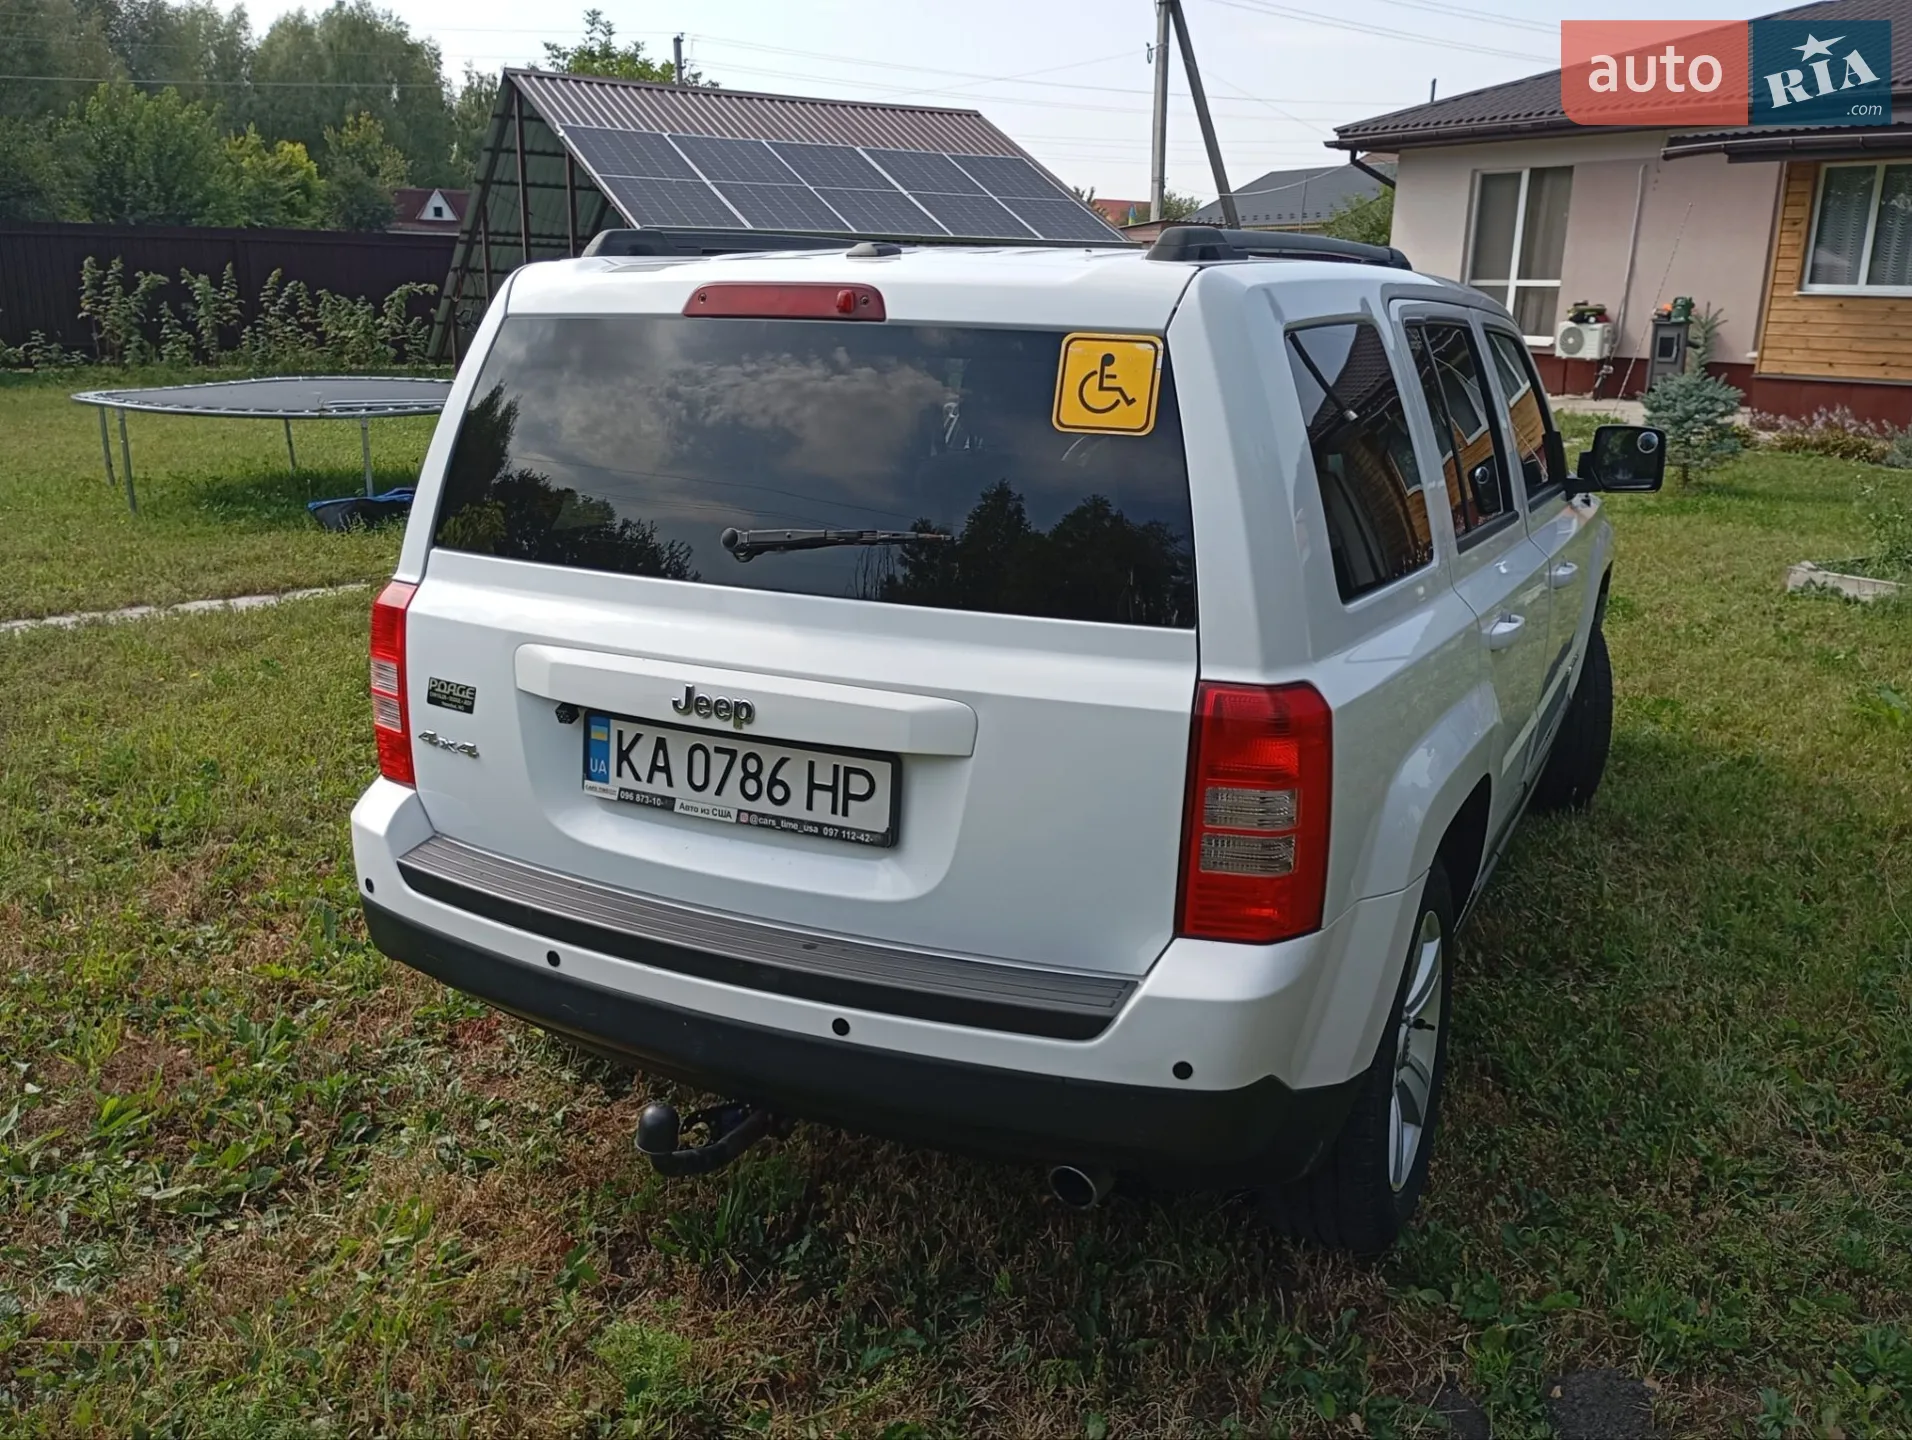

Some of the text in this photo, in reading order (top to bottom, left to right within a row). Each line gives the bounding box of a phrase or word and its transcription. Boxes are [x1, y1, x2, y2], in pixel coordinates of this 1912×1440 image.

[671, 683, 756, 729] Jeep
[418, 729, 480, 758] 4x4
[590, 758, 607, 775] UA
[616, 730, 877, 817] KA 0786 HP
[620, 791, 635, 801] 096
[679, 802, 732, 819] Авто из США
[749, 814, 819, 834] @cars_time_usa
[822, 828, 839, 838] 097
